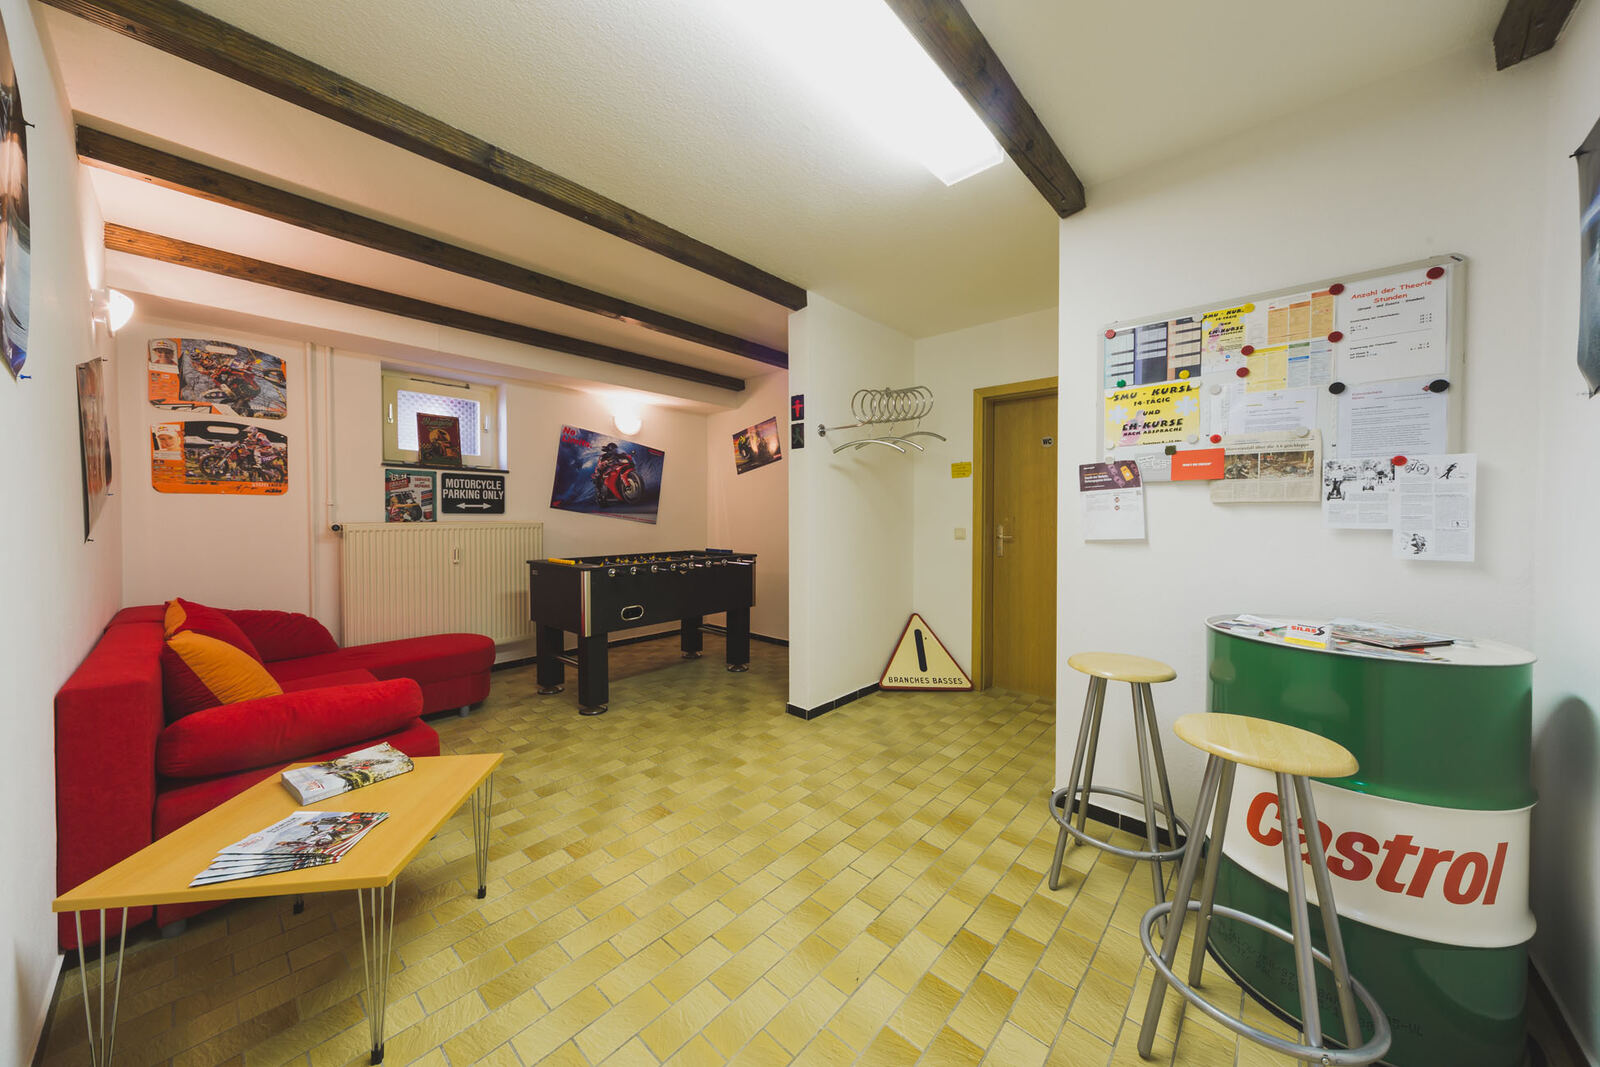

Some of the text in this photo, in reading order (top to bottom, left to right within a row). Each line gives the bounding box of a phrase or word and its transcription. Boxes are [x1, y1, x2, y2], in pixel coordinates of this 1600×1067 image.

[1351, 280, 1433, 300] Anzahl der Theorie
[1373, 293, 1408, 304] Stunden
[1113, 391, 1138, 402] SMU
[1122, 418, 1184, 431] EH-KURSE
[562, 426, 576, 436] No
[1142, 427, 1183, 435] ABSPRACHE
[561, 435, 593, 449] Limits.
[445, 478, 502, 490] MOTORCYCLE
[442, 489, 504, 500] PARKING ONLY
[888, 676, 963, 685] BRANCHES BASSES
